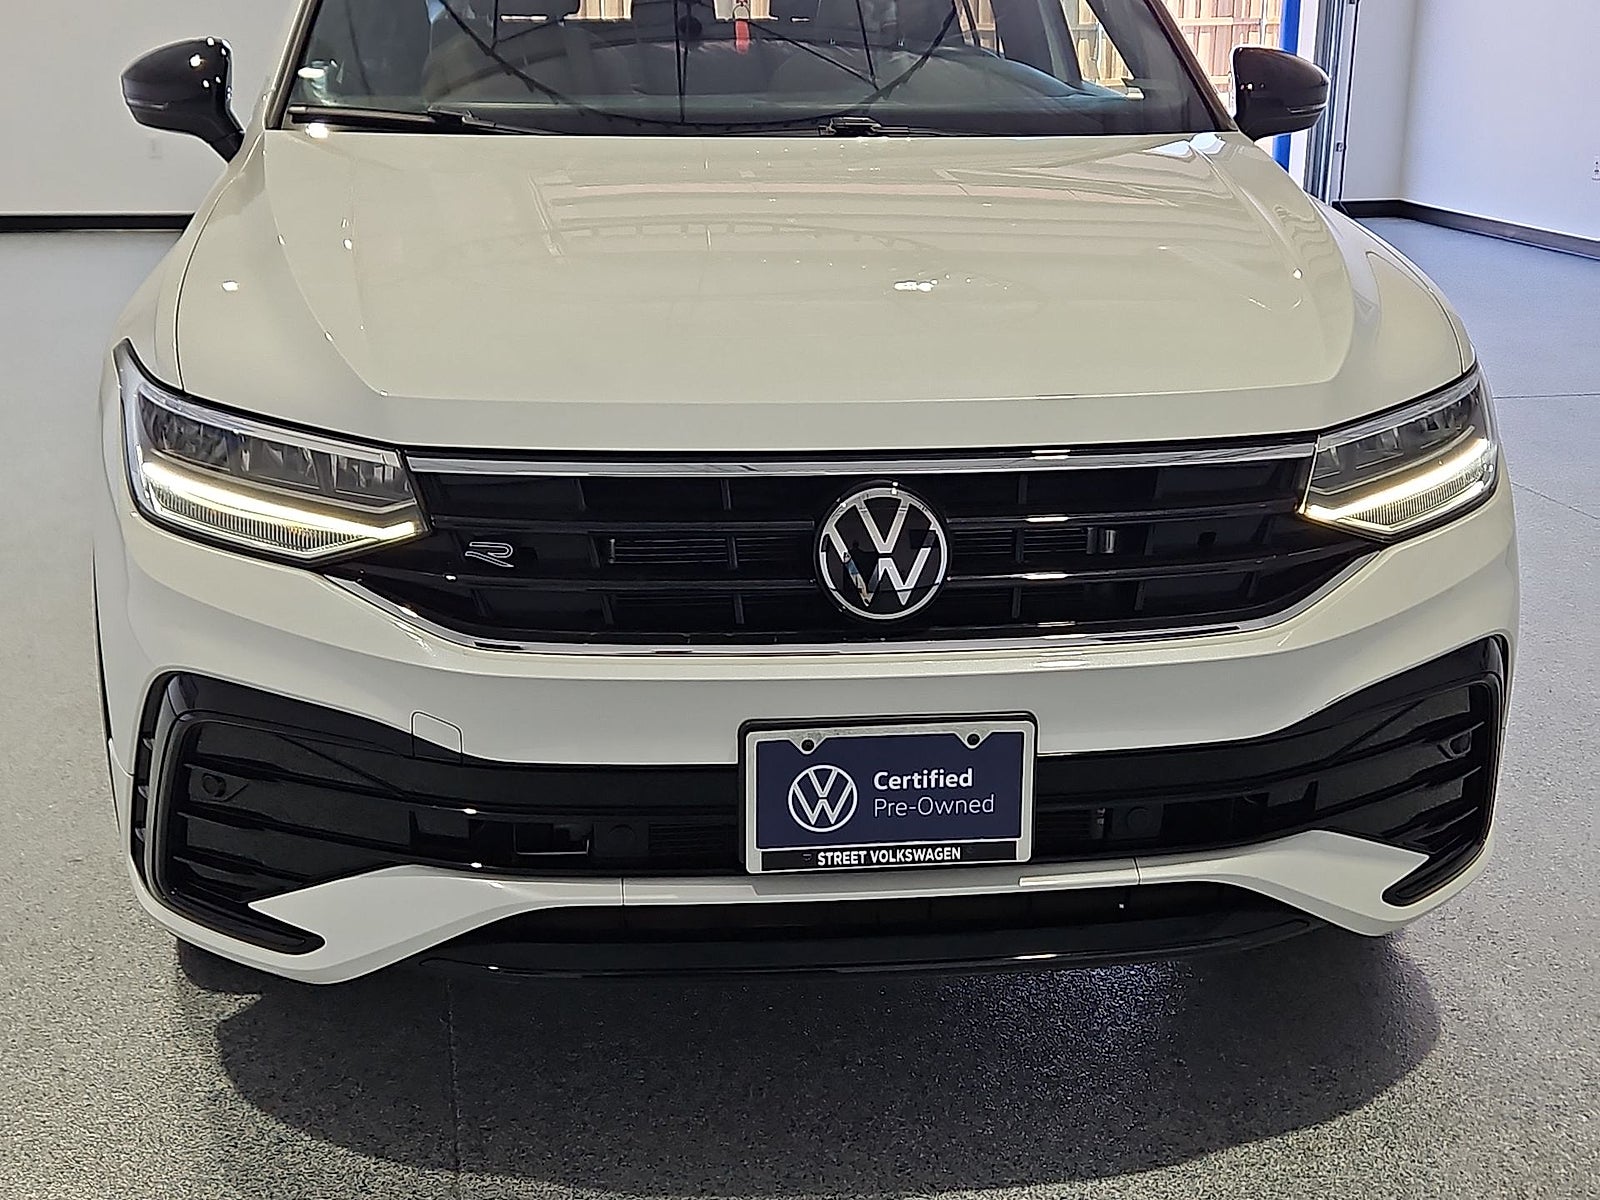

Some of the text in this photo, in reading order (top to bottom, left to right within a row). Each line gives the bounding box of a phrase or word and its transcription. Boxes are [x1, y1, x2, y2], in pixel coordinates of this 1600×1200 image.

[873, 768, 973, 790] Certified
[874, 794, 995, 817] Pre-Owned
[817, 847, 961, 866] STREET VOLKSWAGEN
